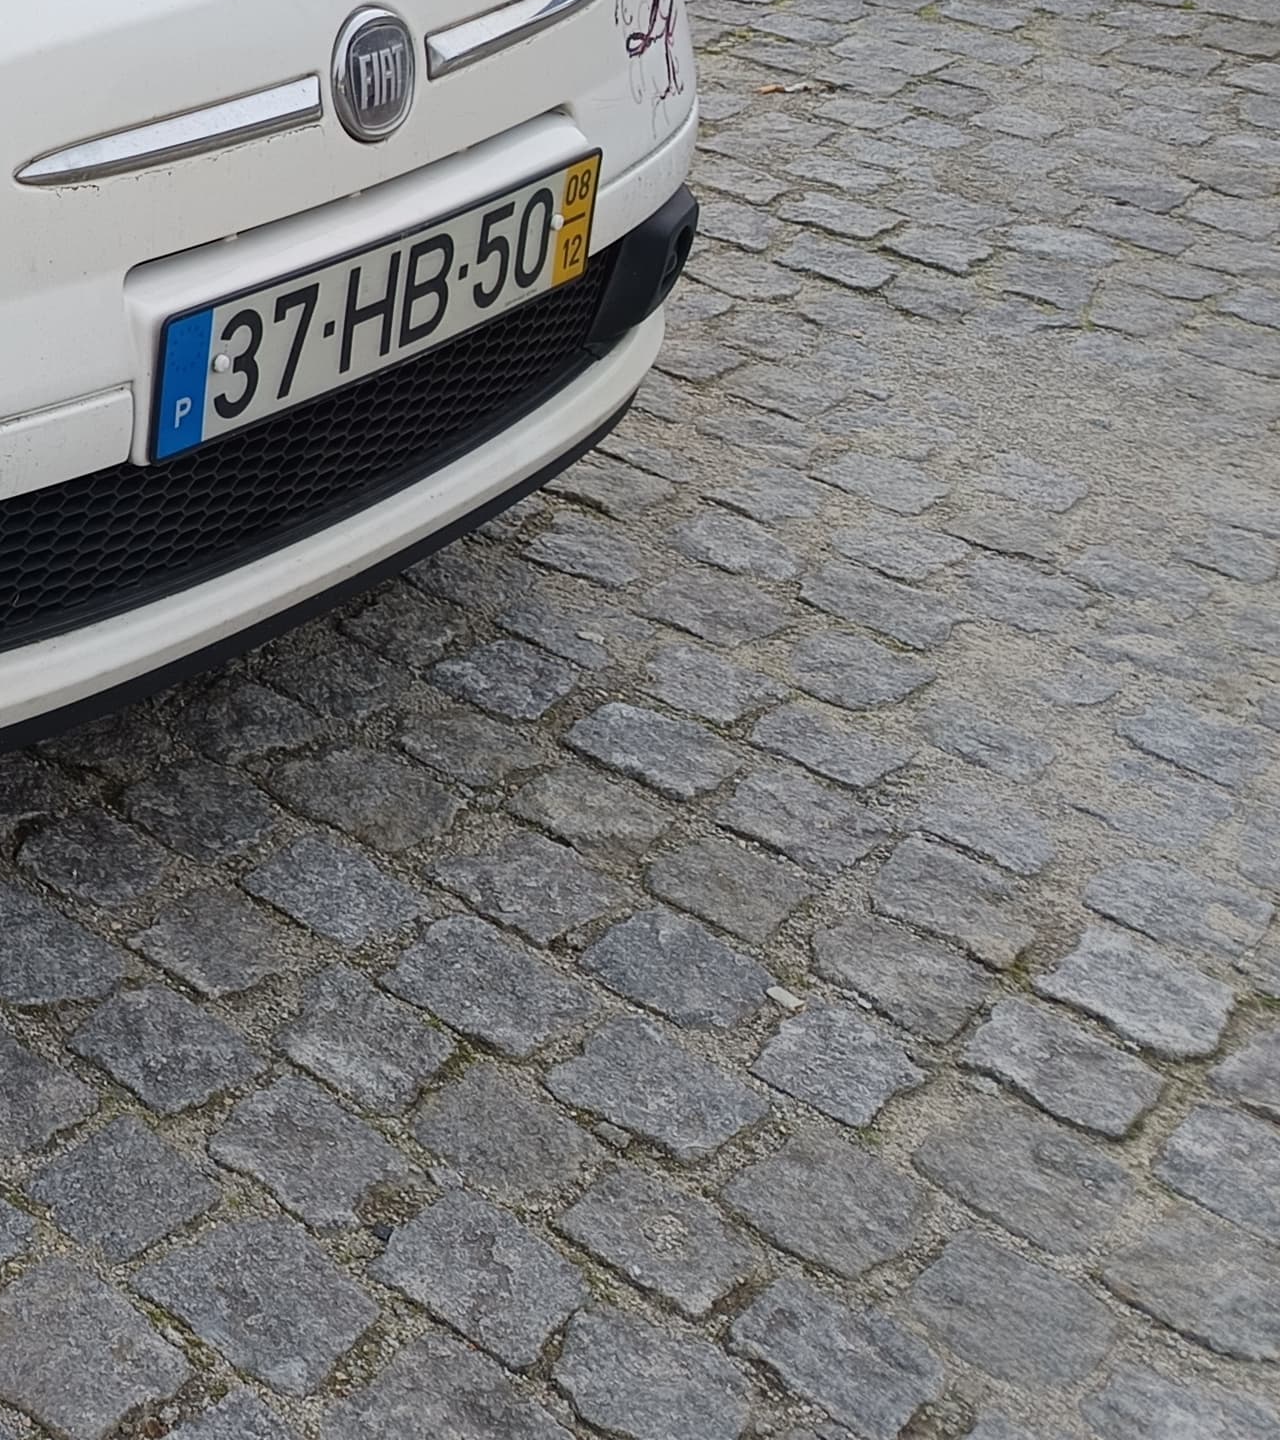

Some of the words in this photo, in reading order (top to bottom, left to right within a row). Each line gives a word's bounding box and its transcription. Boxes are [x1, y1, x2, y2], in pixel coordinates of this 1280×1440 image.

[358, 43, 404, 111] FIAT
[565, 169, 591, 206] 08
[561, 234, 583, 270] 12
[173, 396, 192, 429] P
